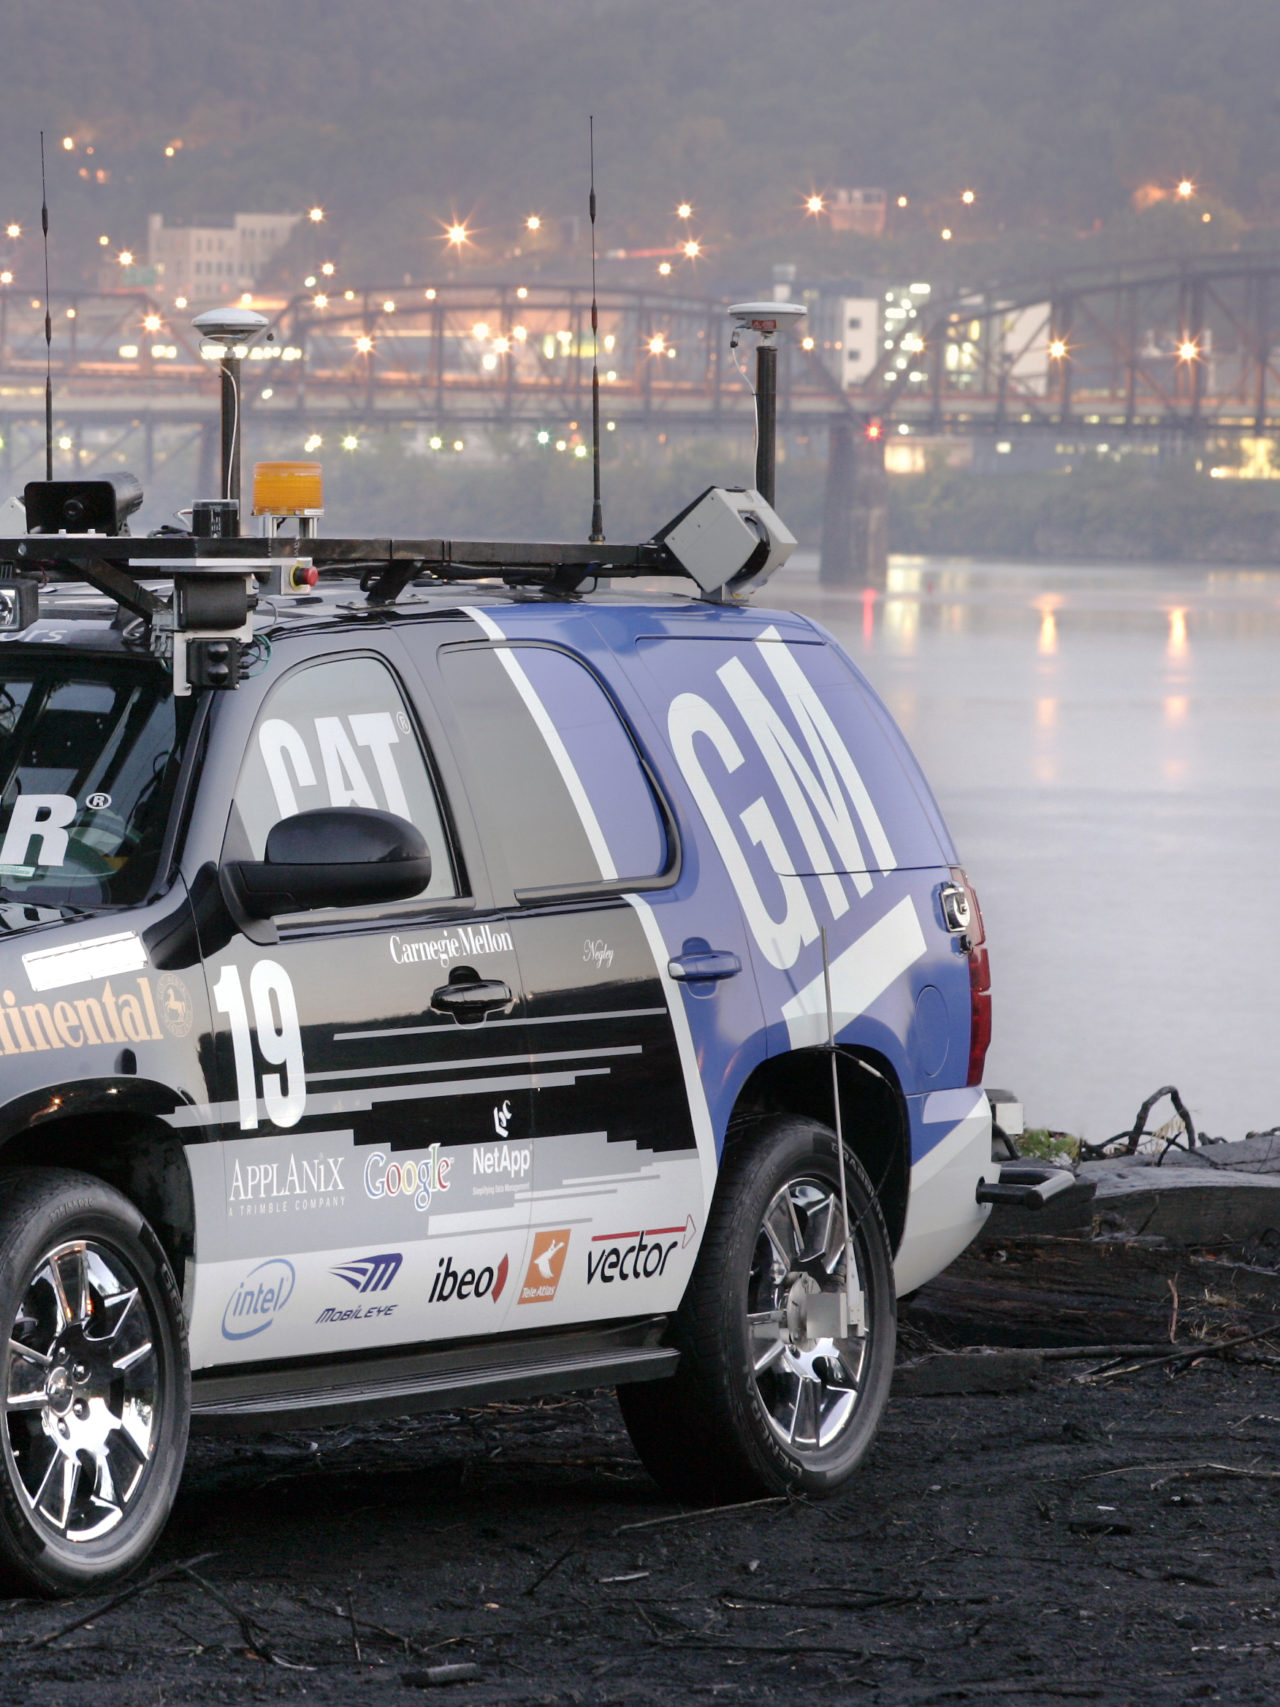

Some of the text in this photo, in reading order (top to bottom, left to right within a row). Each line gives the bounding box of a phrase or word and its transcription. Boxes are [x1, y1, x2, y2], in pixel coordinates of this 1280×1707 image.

[668, 625, 898, 969] GM
[389, 924, 514, 967] Carnegie Mellon
[583, 939, 614, 968] Negley
[213, 960, 307, 1130] 19
[364, 1143, 451, 1212] Google
[473, 1144, 531, 1178] NetApp
[240, 1201, 288, 1216] TRIMBLE
[295, 1196, 346, 1211] COMPANY
[428, 1256, 494, 1303] ibeo
[587, 1230, 678, 1285] vector
[233, 1277, 284, 1317] intel
